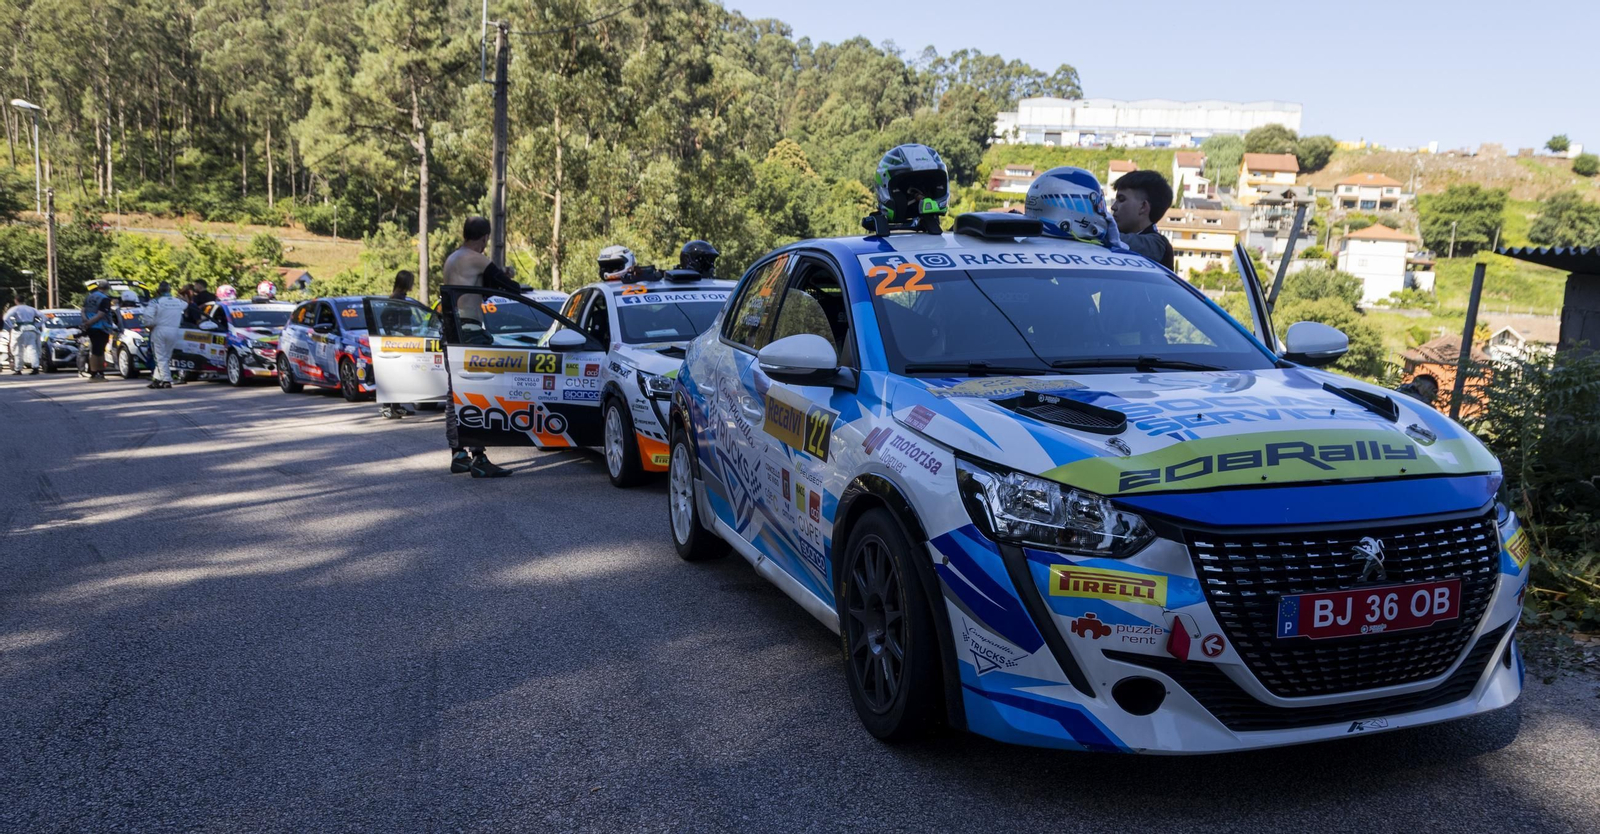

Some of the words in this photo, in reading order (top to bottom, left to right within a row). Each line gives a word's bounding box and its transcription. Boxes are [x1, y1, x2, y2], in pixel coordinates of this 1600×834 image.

[959, 253, 1033, 265] RACE
[1034, 253, 1089, 266] FOR
[1090, 255, 1156, 270] GOOD
[868, 263, 934, 296] 22
[621, 285, 648, 295] 23
[702, 293, 727, 301] FOR
[231, 311, 244, 319] 19
[341, 309, 359, 318] 42
[480, 303, 498, 314] 16
[215, 336, 225, 345] 19
[384, 340, 421, 349] Recalvi
[468, 355, 523, 368] Recalvi
[534, 353, 557, 373] 23
[979, 379, 1016, 388] 22
[564, 390, 601, 400] sparco
[456, 404, 568, 435] endio
[718, 376, 756, 449] Campanilla
[767, 396, 803, 437] Recalvi
[807, 409, 830, 458] 22
[716, 413, 750, 482] TRUCKS
[889, 434, 943, 475] motorisa
[879, 447, 907, 475] lloguer
[799, 469, 823, 487] PEUGEOT
[800, 540, 826, 570] sparco
[1059, 570, 1157, 599] PIRELLI
[1313, 597, 1353, 628] BJ
[1365, 592, 1399, 623] 36
[1410, 587, 1450, 617] OB
[1116, 625, 1163, 636] puzzle
[1284, 621, 1293, 634] P
[1121, 635, 1156, 645] rent
[970, 638, 1006, 664] TRUCKS
